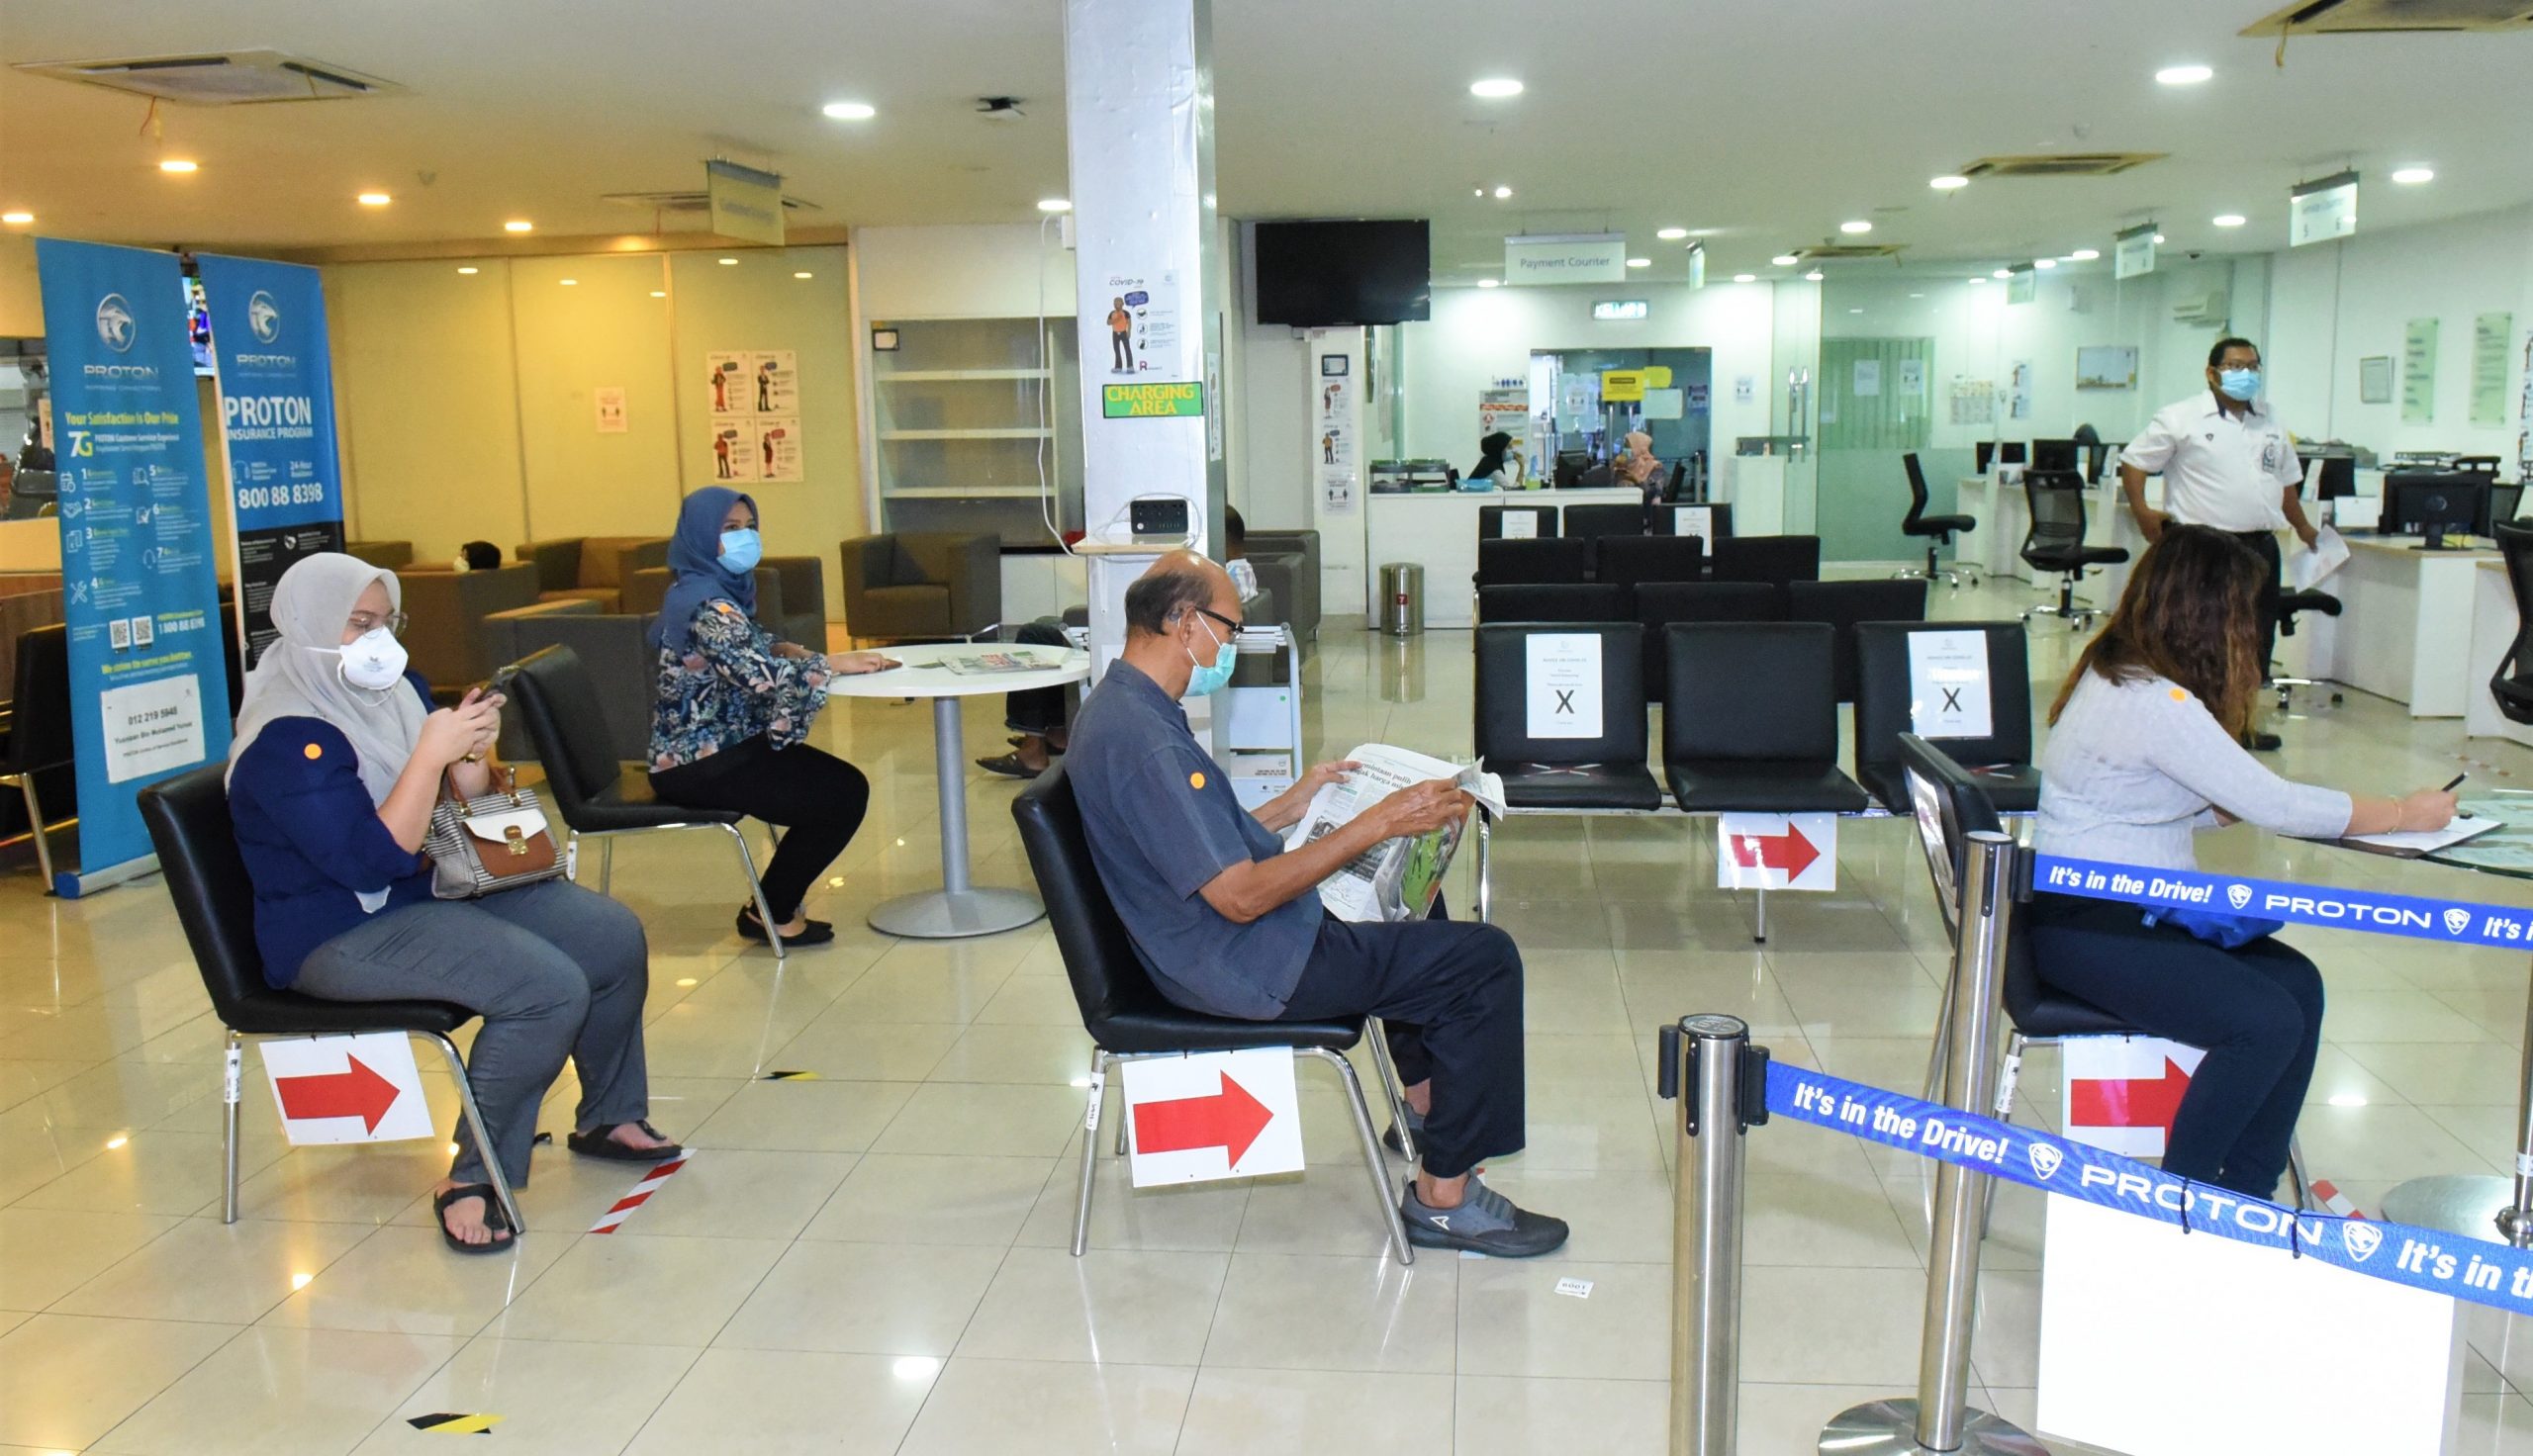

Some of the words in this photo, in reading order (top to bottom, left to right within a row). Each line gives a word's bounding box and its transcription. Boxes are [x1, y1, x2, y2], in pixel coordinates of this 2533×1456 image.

[1520, 257, 1565, 270] Payment
[1568, 257, 1610, 267] Counter
[84, 365, 158, 378] PROTON
[1107, 384, 1194, 402] CHARGING
[65, 411, 87, 425] Your
[225, 396, 312, 426] PROTON
[1130, 399, 1177, 415] AREA
[84, 498, 91, 509] 2
[271, 485, 290, 505] 88
[293, 483, 324, 504] 8398
[86, 527, 93, 540] 3
[91, 578, 98, 589] 4
[1555, 689, 1575, 714] X
[1942, 687, 1962, 712] X
[2050, 865, 2081, 886] It's
[2086, 869, 2106, 889] in
[2111, 873, 2144, 894] the
[2149, 877, 2212, 902] Drive!
[2266, 894, 2431, 928] PROTON
[2484, 916, 2521, 939] It's
[1794, 1082, 1834, 1116] It's
[1840, 1095, 1866, 1126] in
[1873, 1106, 1917, 1138] the
[1922, 1119, 2010, 1163] Drive!
[2082, 1164, 2323, 1246] PROTON
[2396, 1238, 2458, 1280] It's
[2463, 1254, 2502, 1291] in
